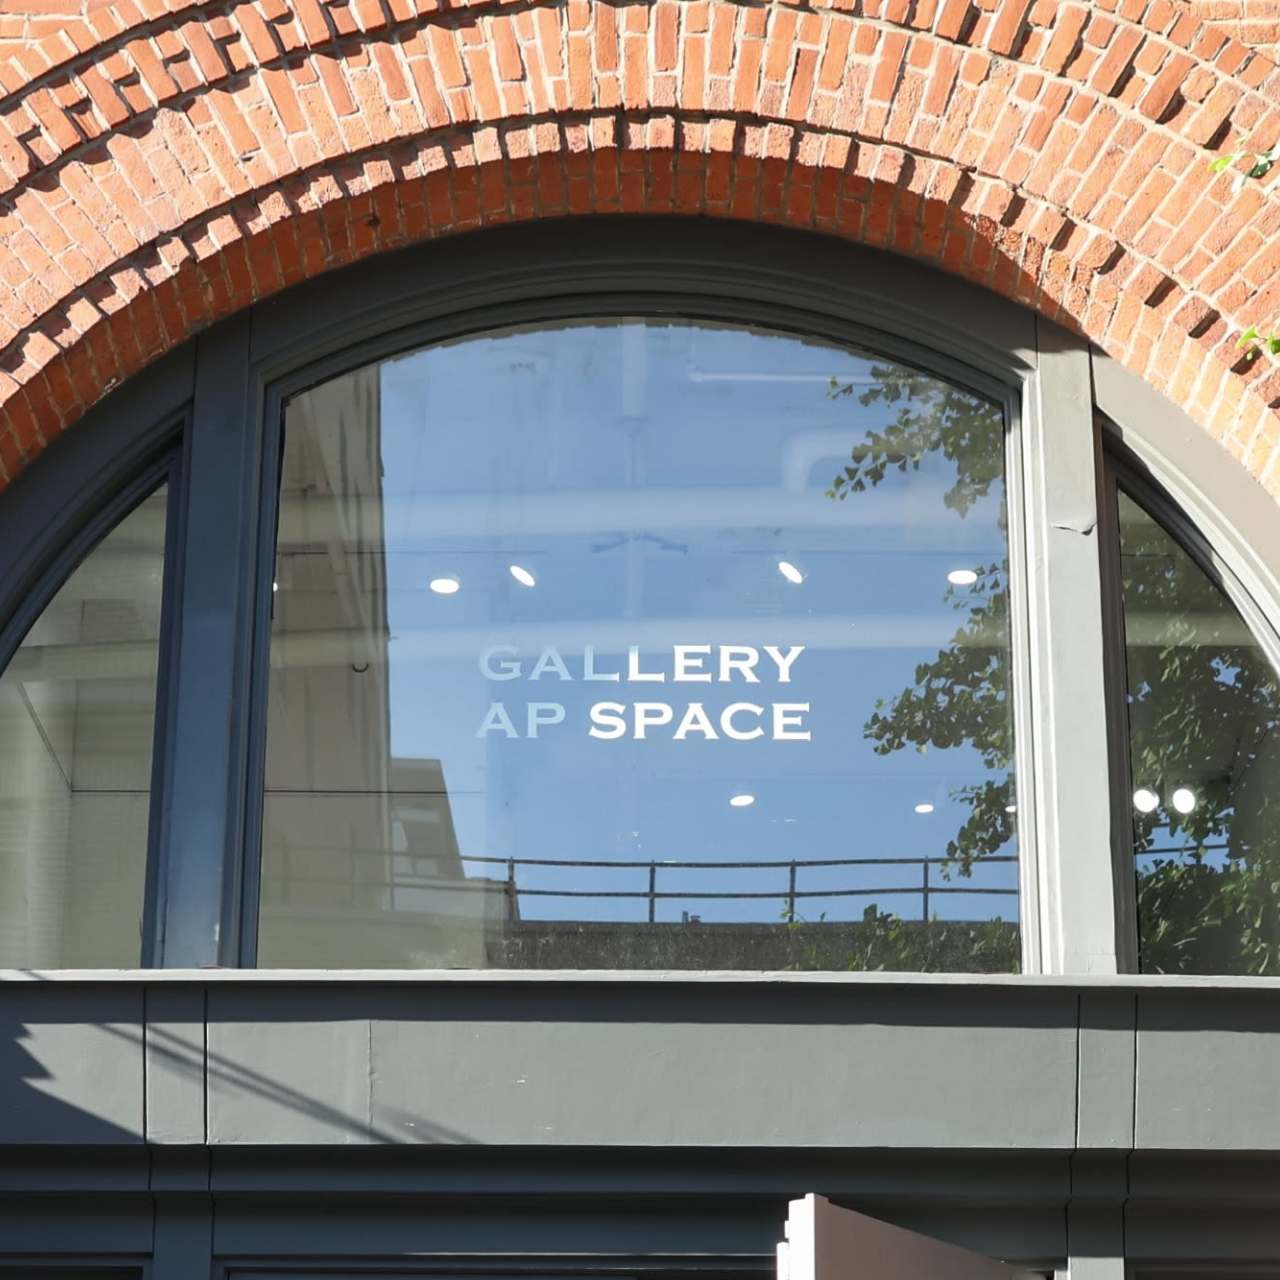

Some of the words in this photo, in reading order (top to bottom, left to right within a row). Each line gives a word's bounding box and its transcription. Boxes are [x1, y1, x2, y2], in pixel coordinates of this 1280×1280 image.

[477, 644, 806, 683] GALLERY
[475, 702, 566, 739] AP
[588, 702, 812, 741] SPACE
